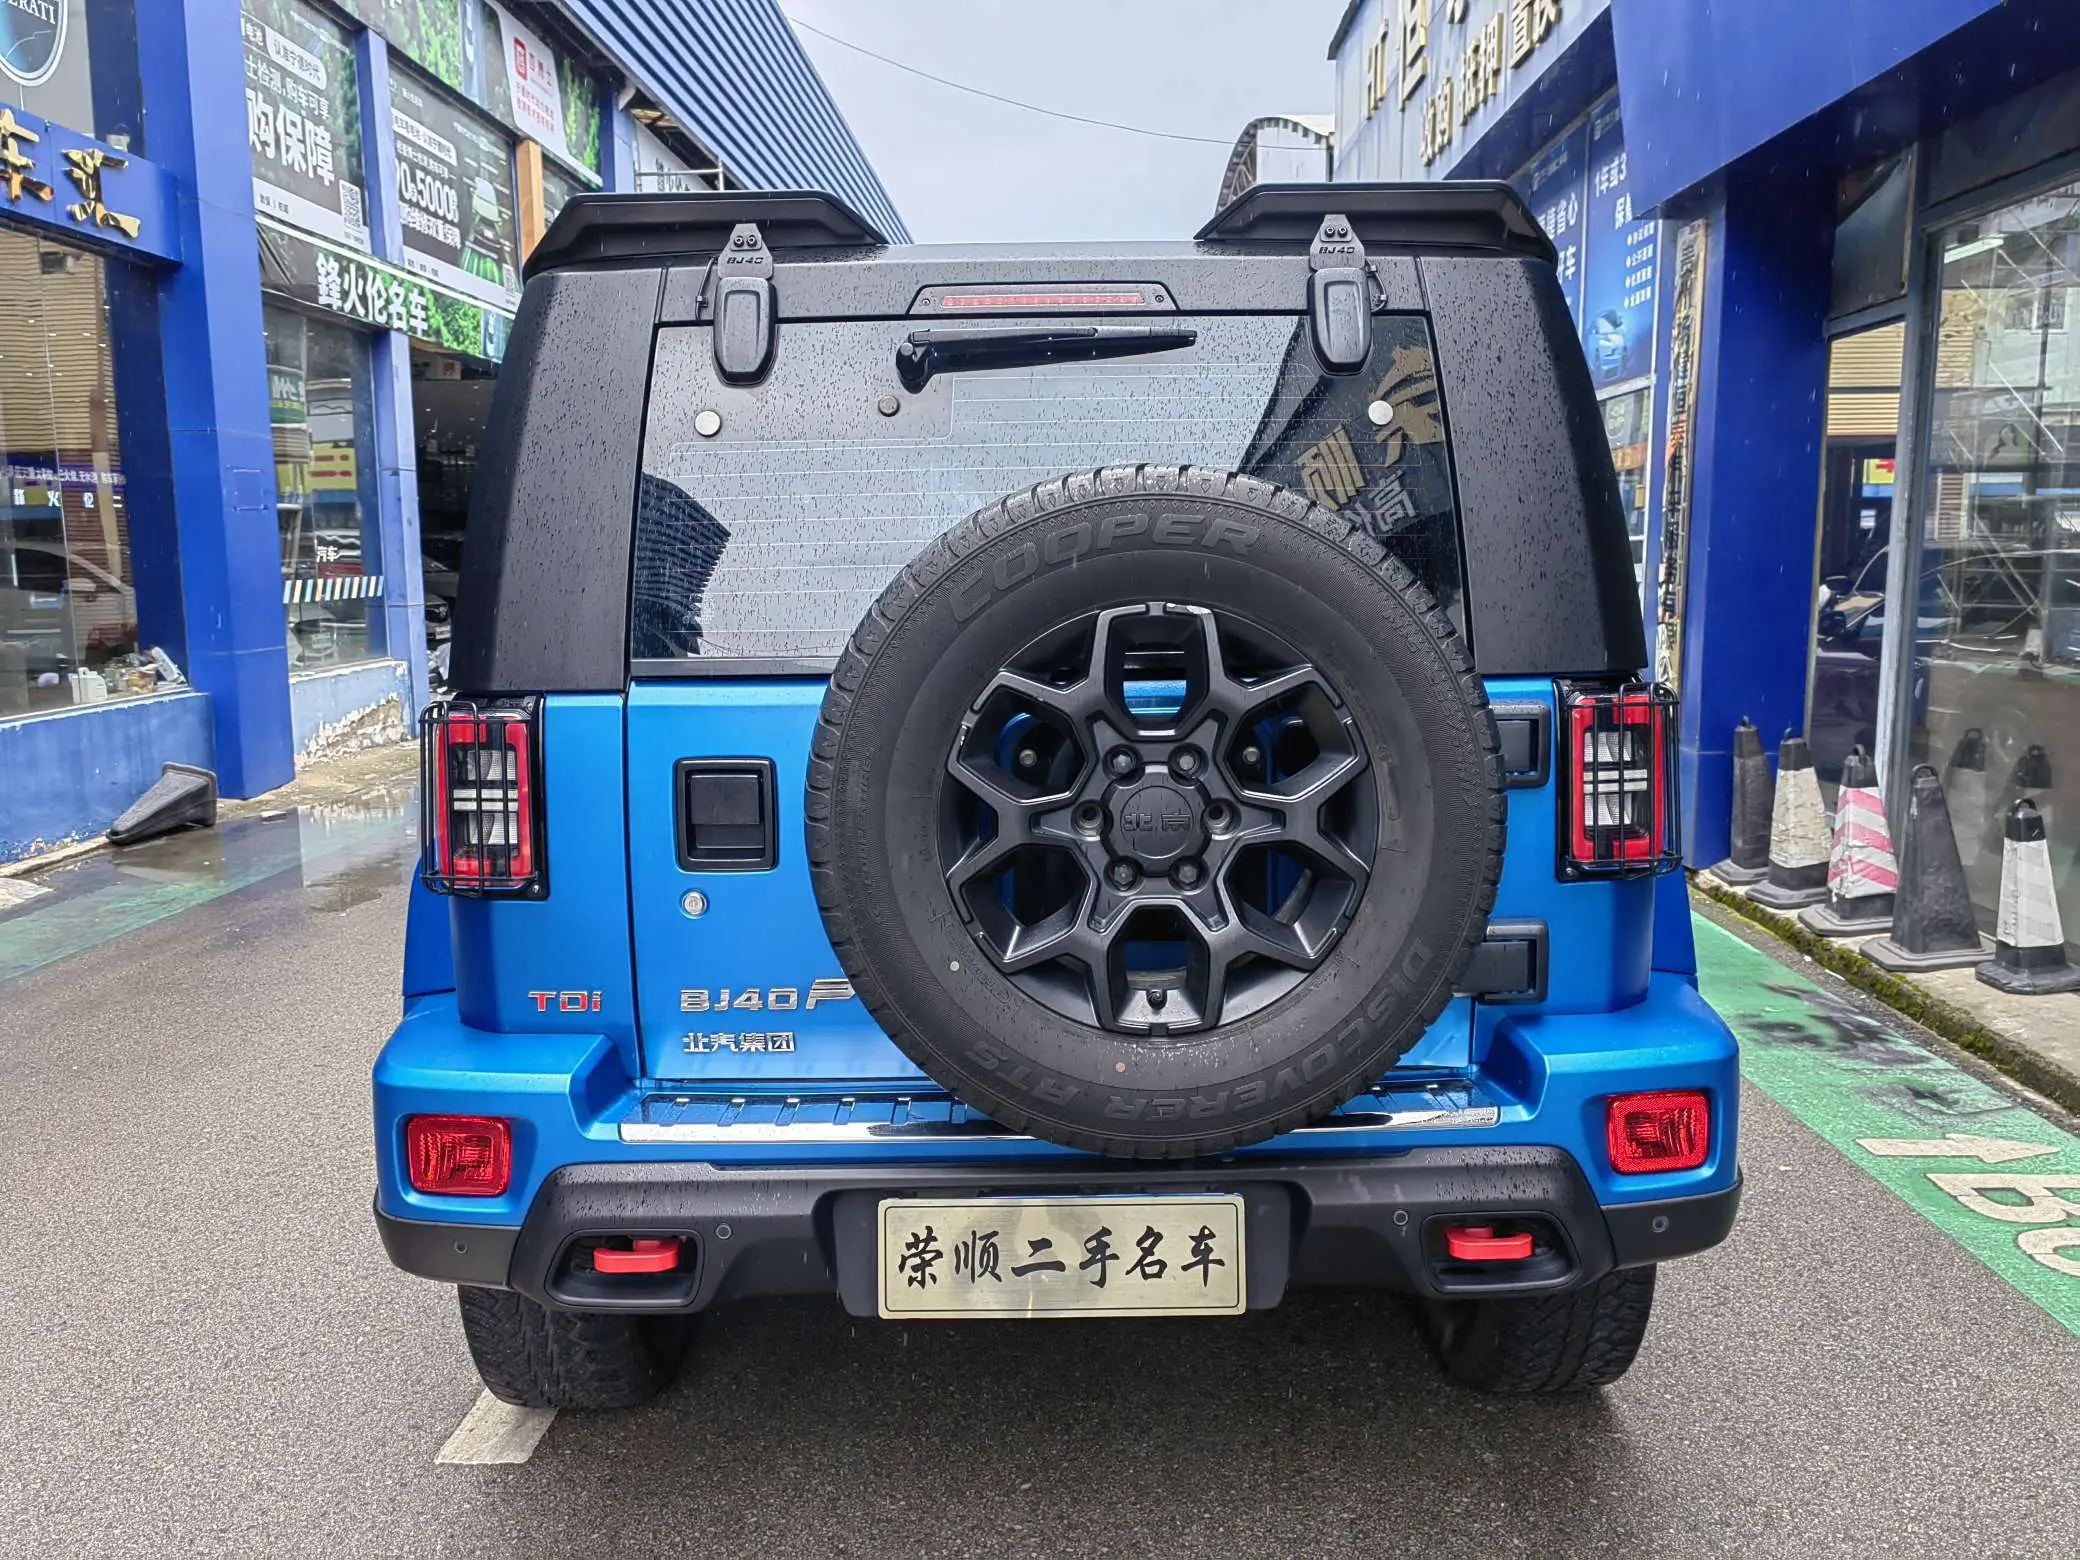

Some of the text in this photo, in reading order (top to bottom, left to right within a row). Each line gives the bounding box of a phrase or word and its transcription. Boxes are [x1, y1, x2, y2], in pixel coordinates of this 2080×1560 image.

[726, 256, 764, 265] BJ40
[1319, 246, 1356, 255] BJ40
[949, 512, 1261, 624] COOPER
[682, 1032, 796, 1053] 北汽集团
[897, 1225, 1226, 1290] 荣顺二手名车
